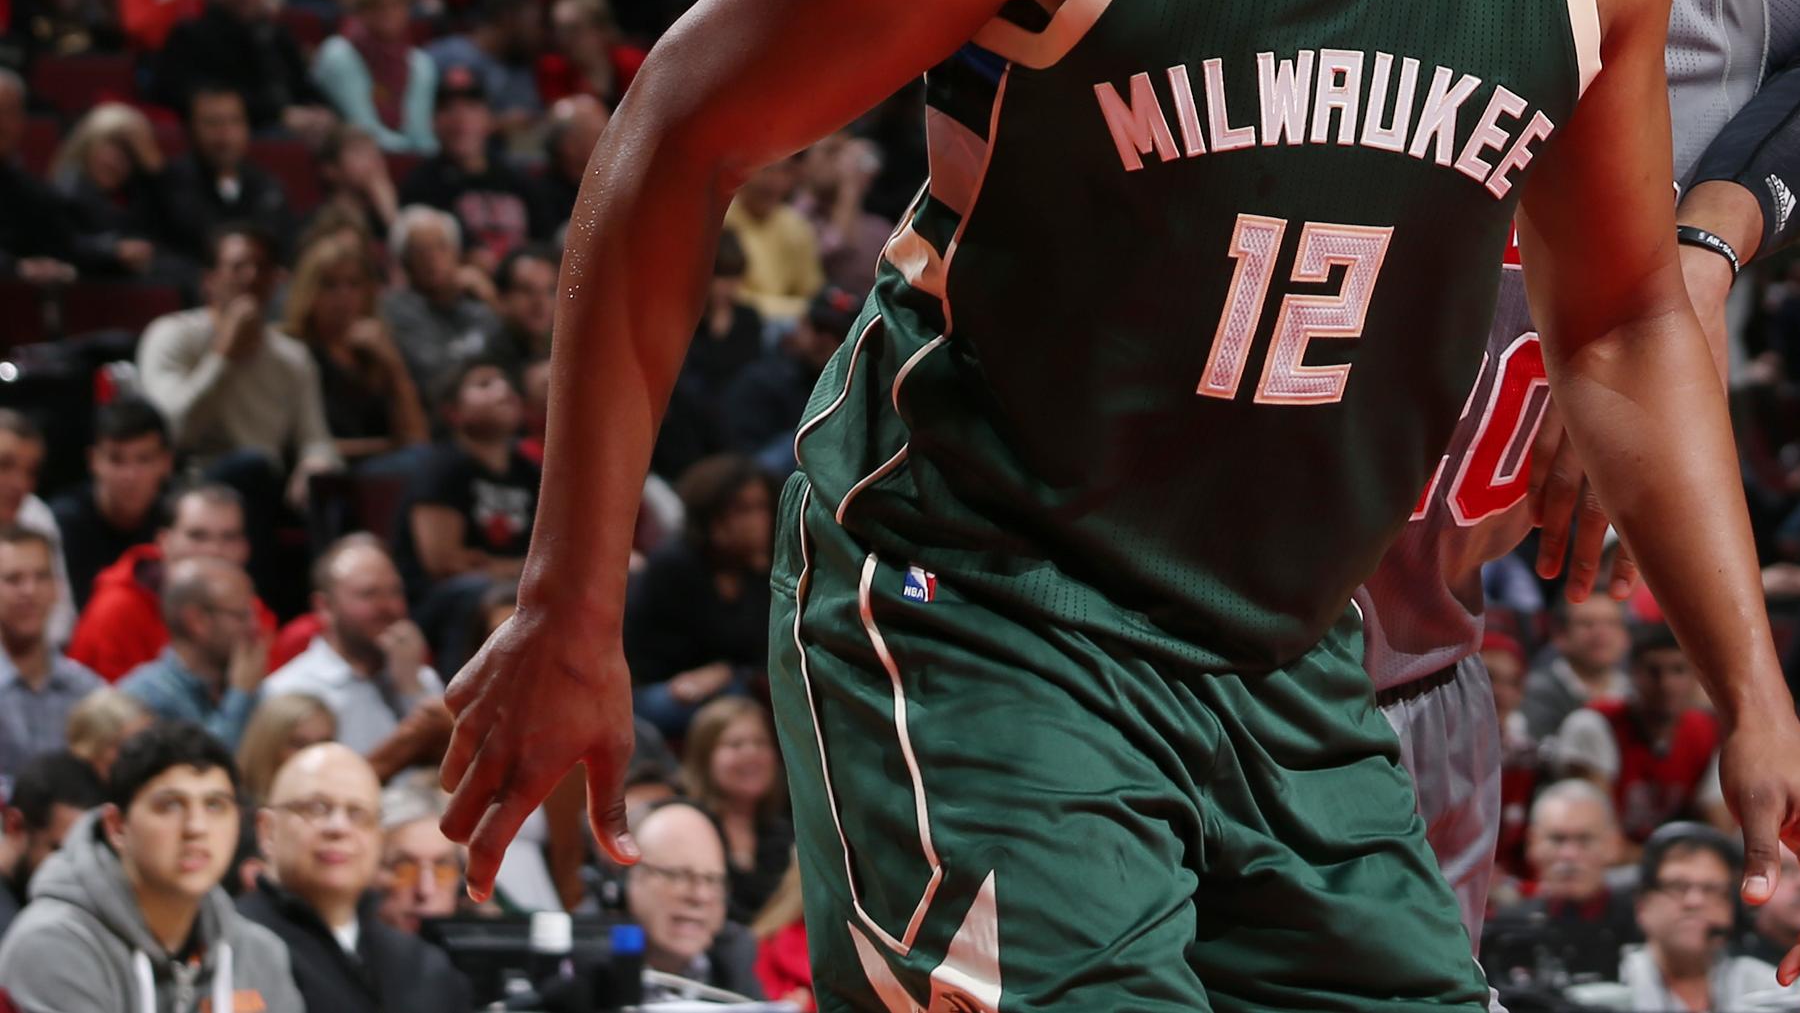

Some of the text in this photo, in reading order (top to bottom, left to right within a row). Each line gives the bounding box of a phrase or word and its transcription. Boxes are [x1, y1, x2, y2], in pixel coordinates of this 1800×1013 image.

[1093, 48, 1556, 200] MILWAUKEE
[1195, 212, 1395, 406] 12
[1408, 331, 1553, 528] 0
[903, 586, 923, 598] NBA
